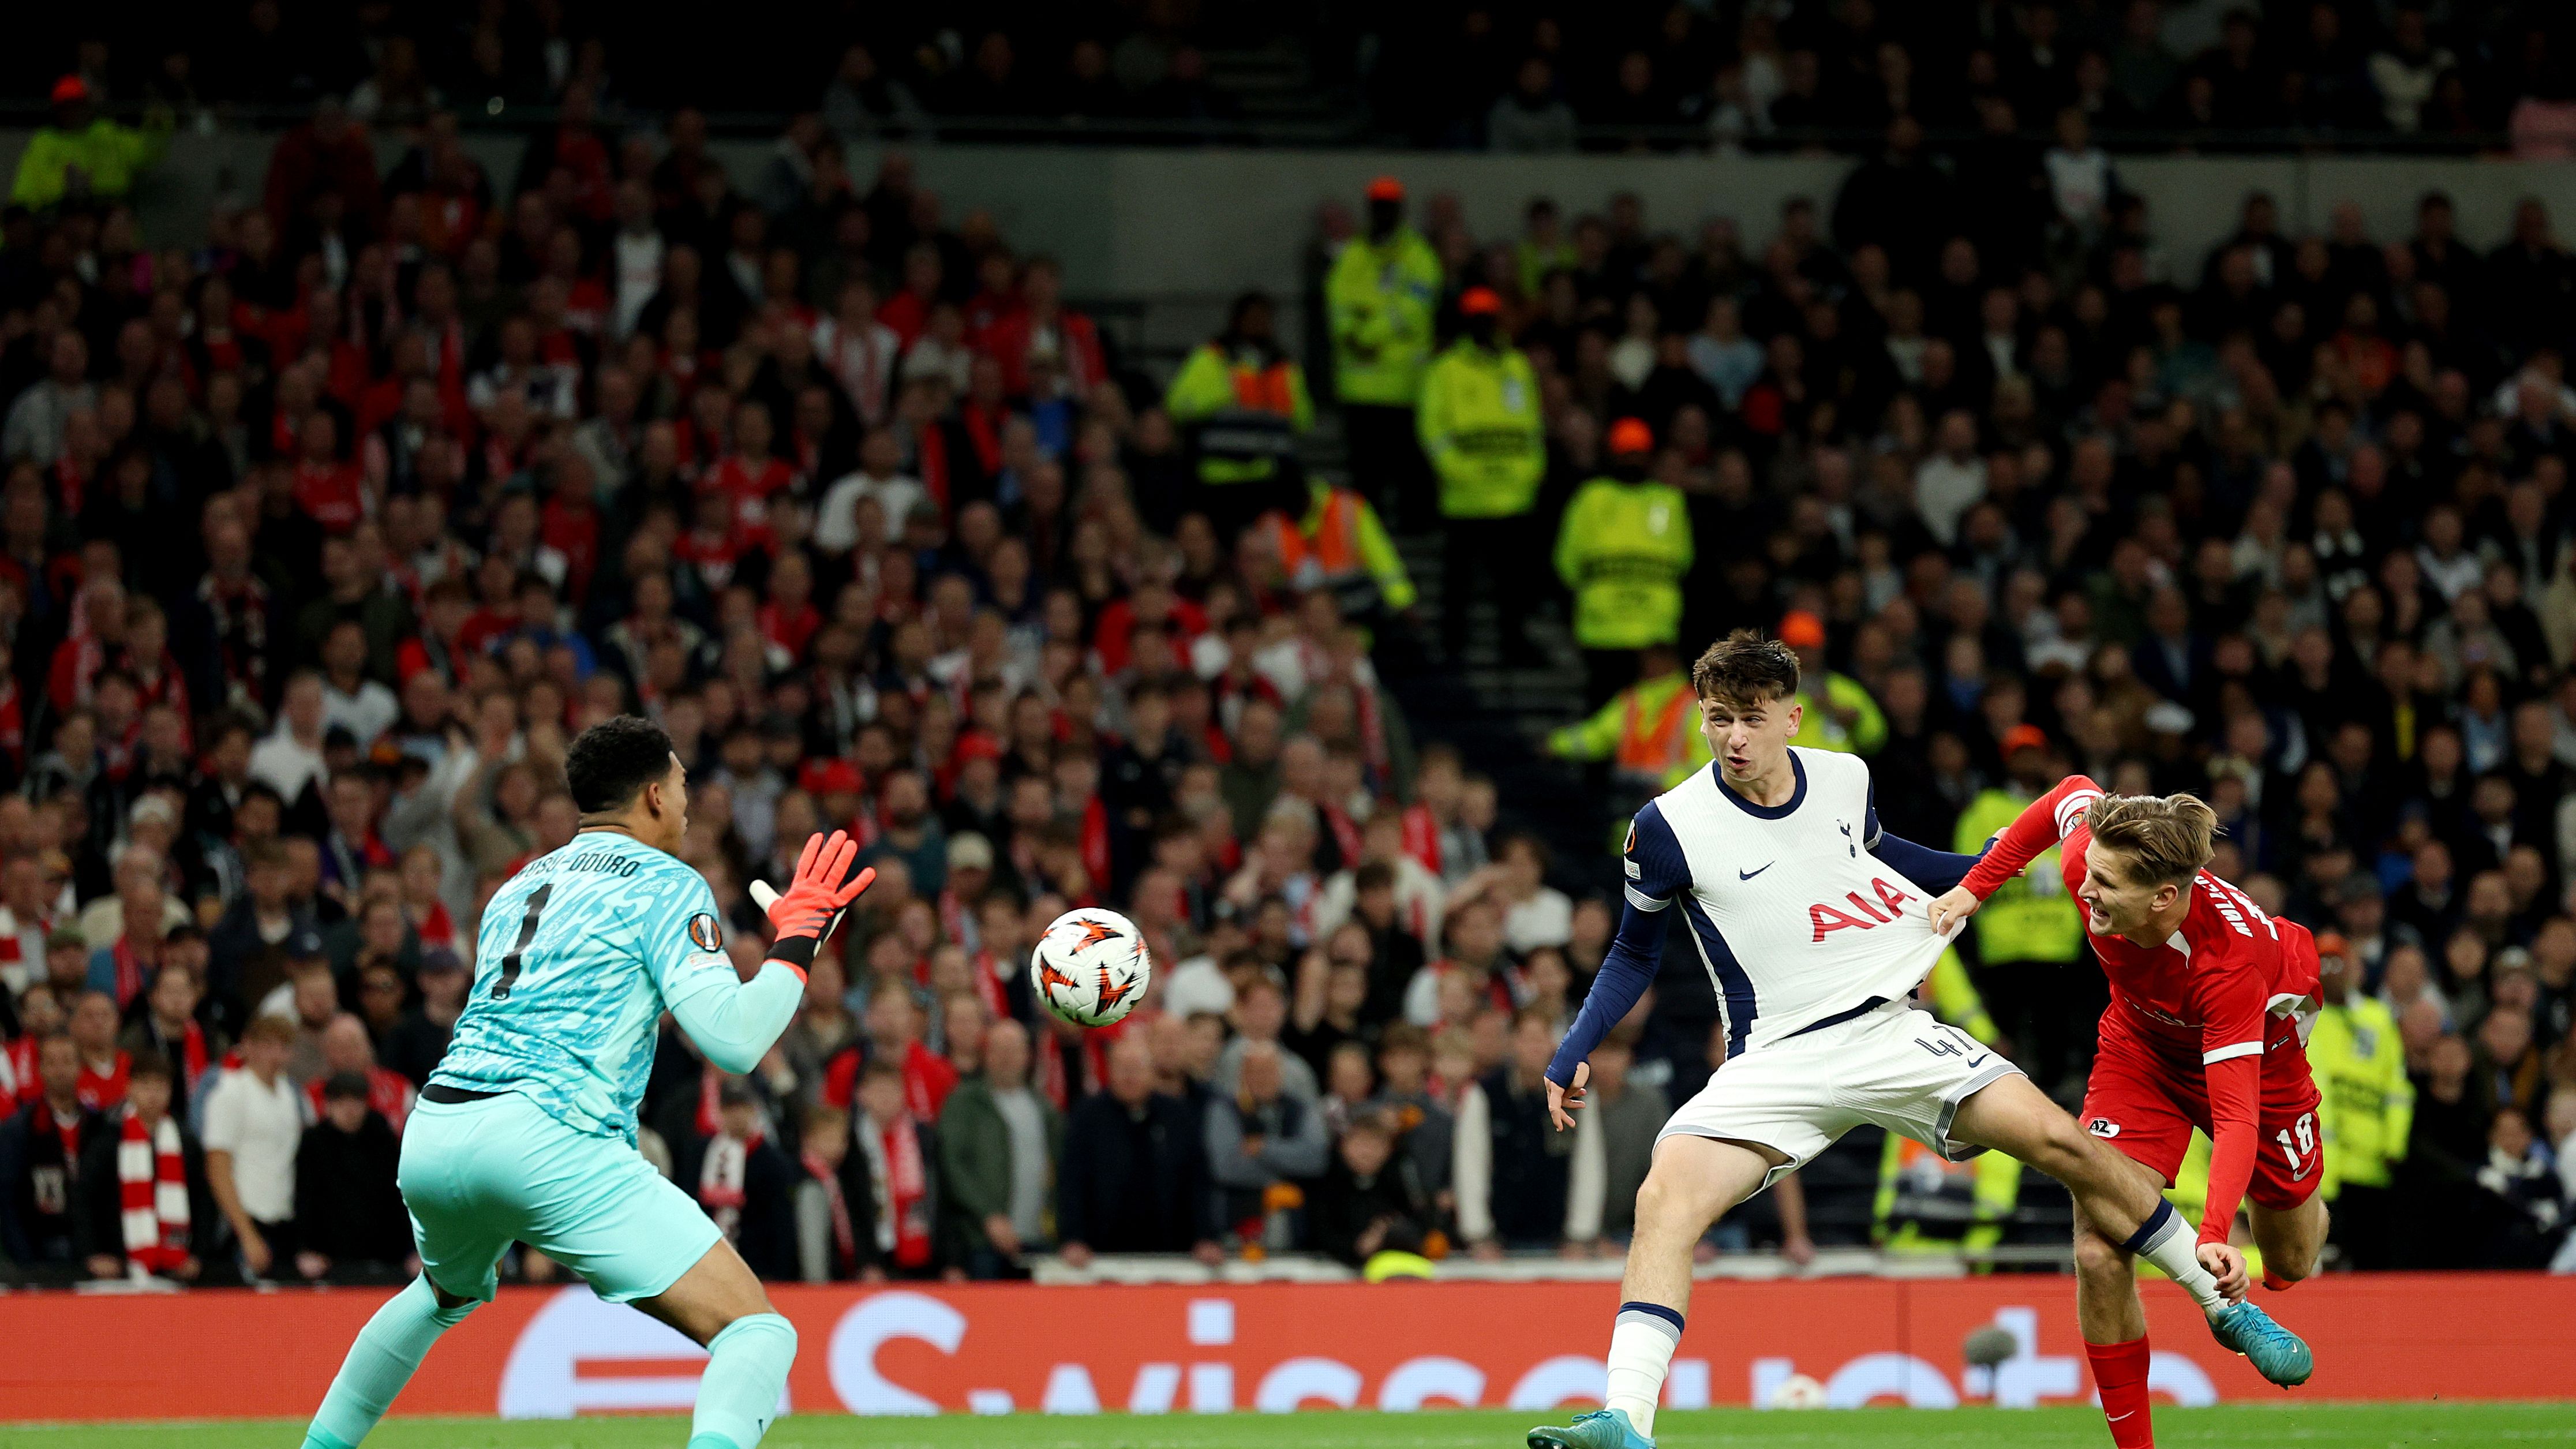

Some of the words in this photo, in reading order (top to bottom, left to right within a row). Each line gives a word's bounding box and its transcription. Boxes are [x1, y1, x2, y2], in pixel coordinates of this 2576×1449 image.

[512, 853, 640, 881] USU-ODURO
[1809, 877, 1918, 942] AIA
[492, 883, 555, 1000] 1
[1914, 1025, 1974, 1057] 47
[2089, 1119, 2110, 1135] AZ
[2276, 1112, 2314, 1170] 18
